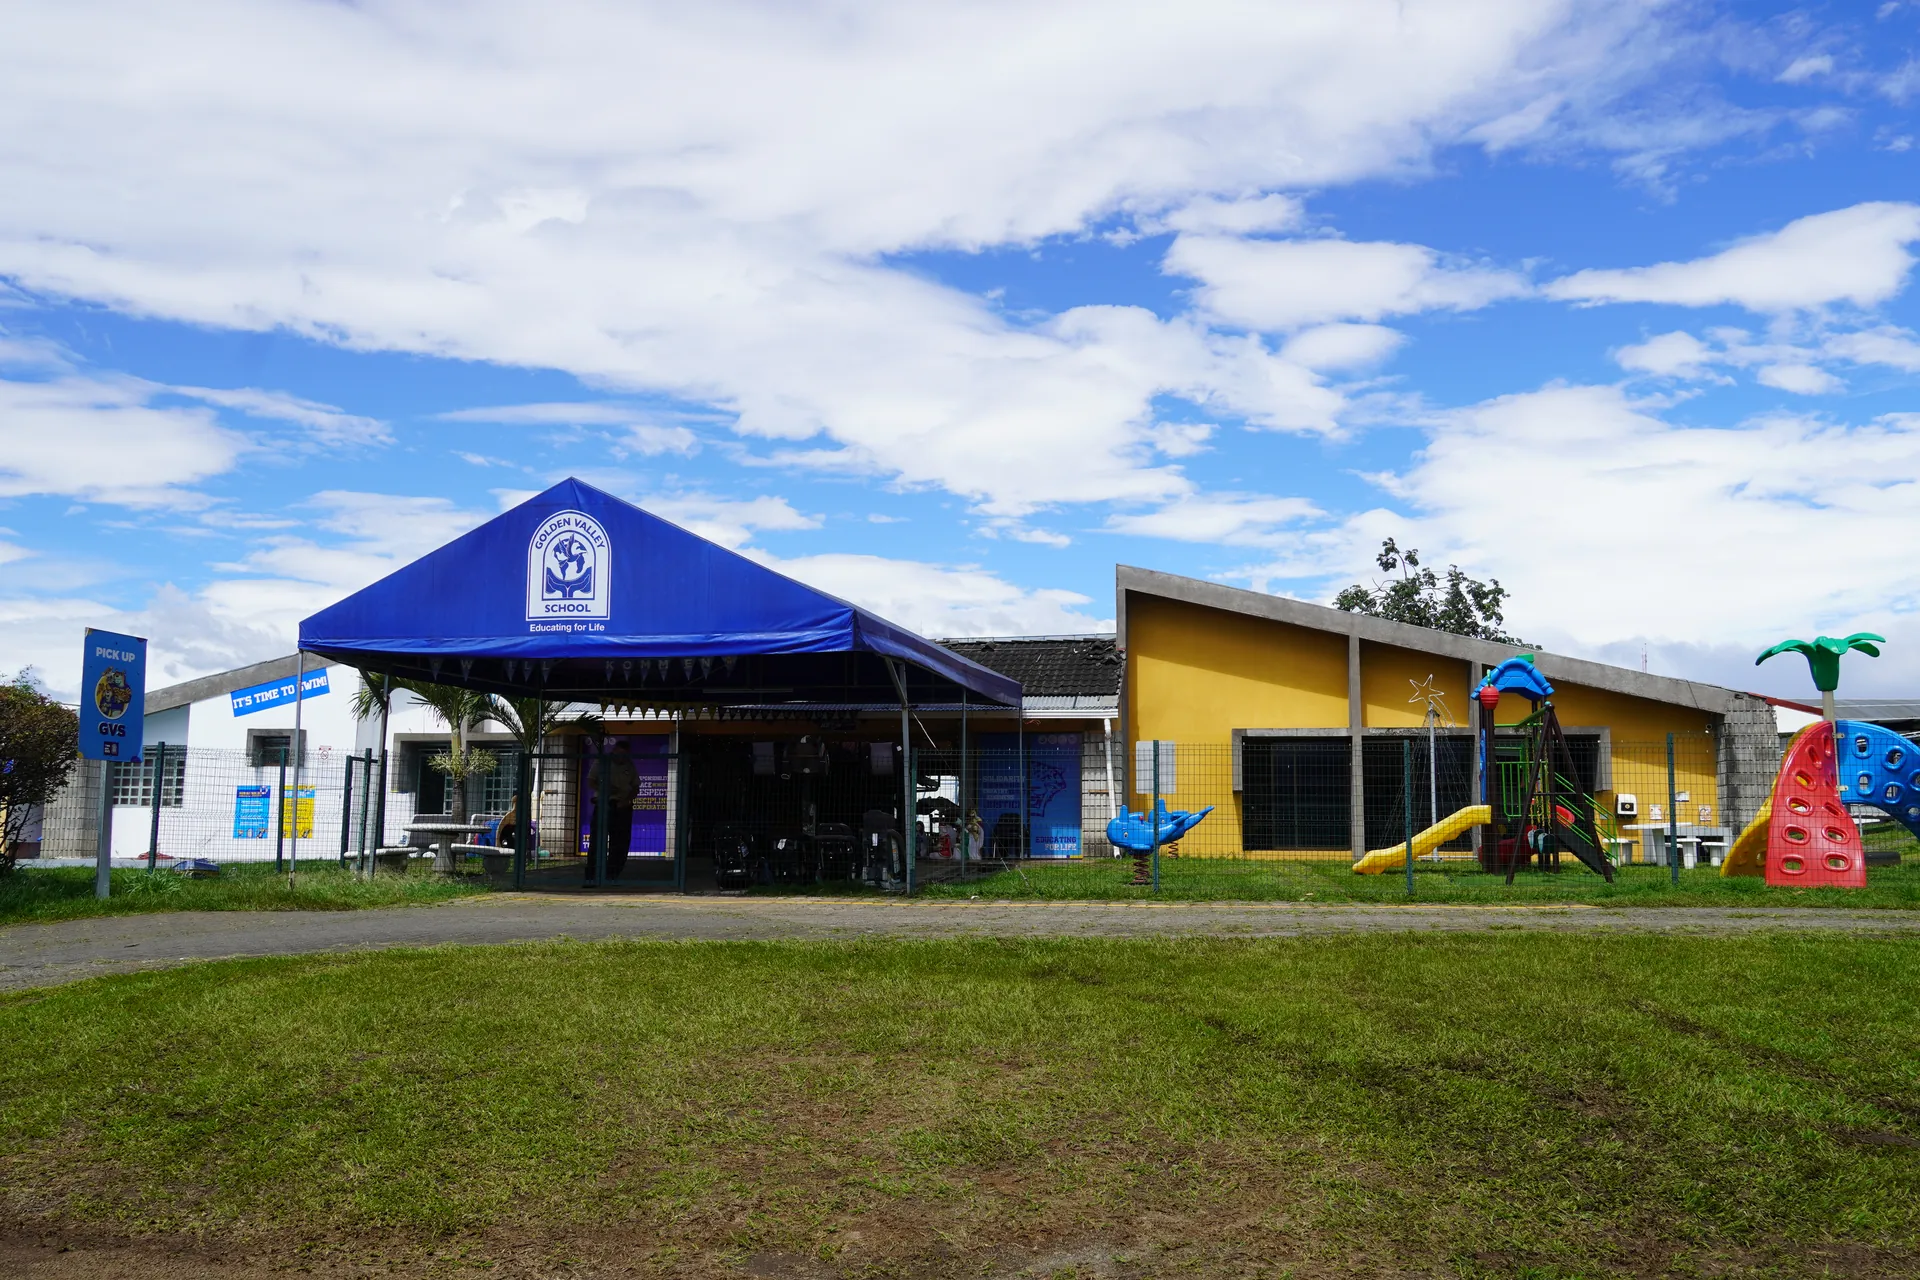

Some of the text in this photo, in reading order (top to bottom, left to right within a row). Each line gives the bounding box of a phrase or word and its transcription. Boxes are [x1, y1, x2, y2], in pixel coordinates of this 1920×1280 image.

[535, 517, 606, 550] GOLDEN VALLEY
[544, 603, 591, 613] SCHOOL
[530, 623, 605, 632] Educating for Life
[95, 646, 136, 663] PICK UP
[233, 695, 253, 709] IT'S
[253, 688, 280, 704] TIME
[280, 684, 295, 697] TO
[97, 721, 126, 737] GVS
[636, 788, 667, 796] ESPECT
[1060, 843, 1077, 851] LIFE
